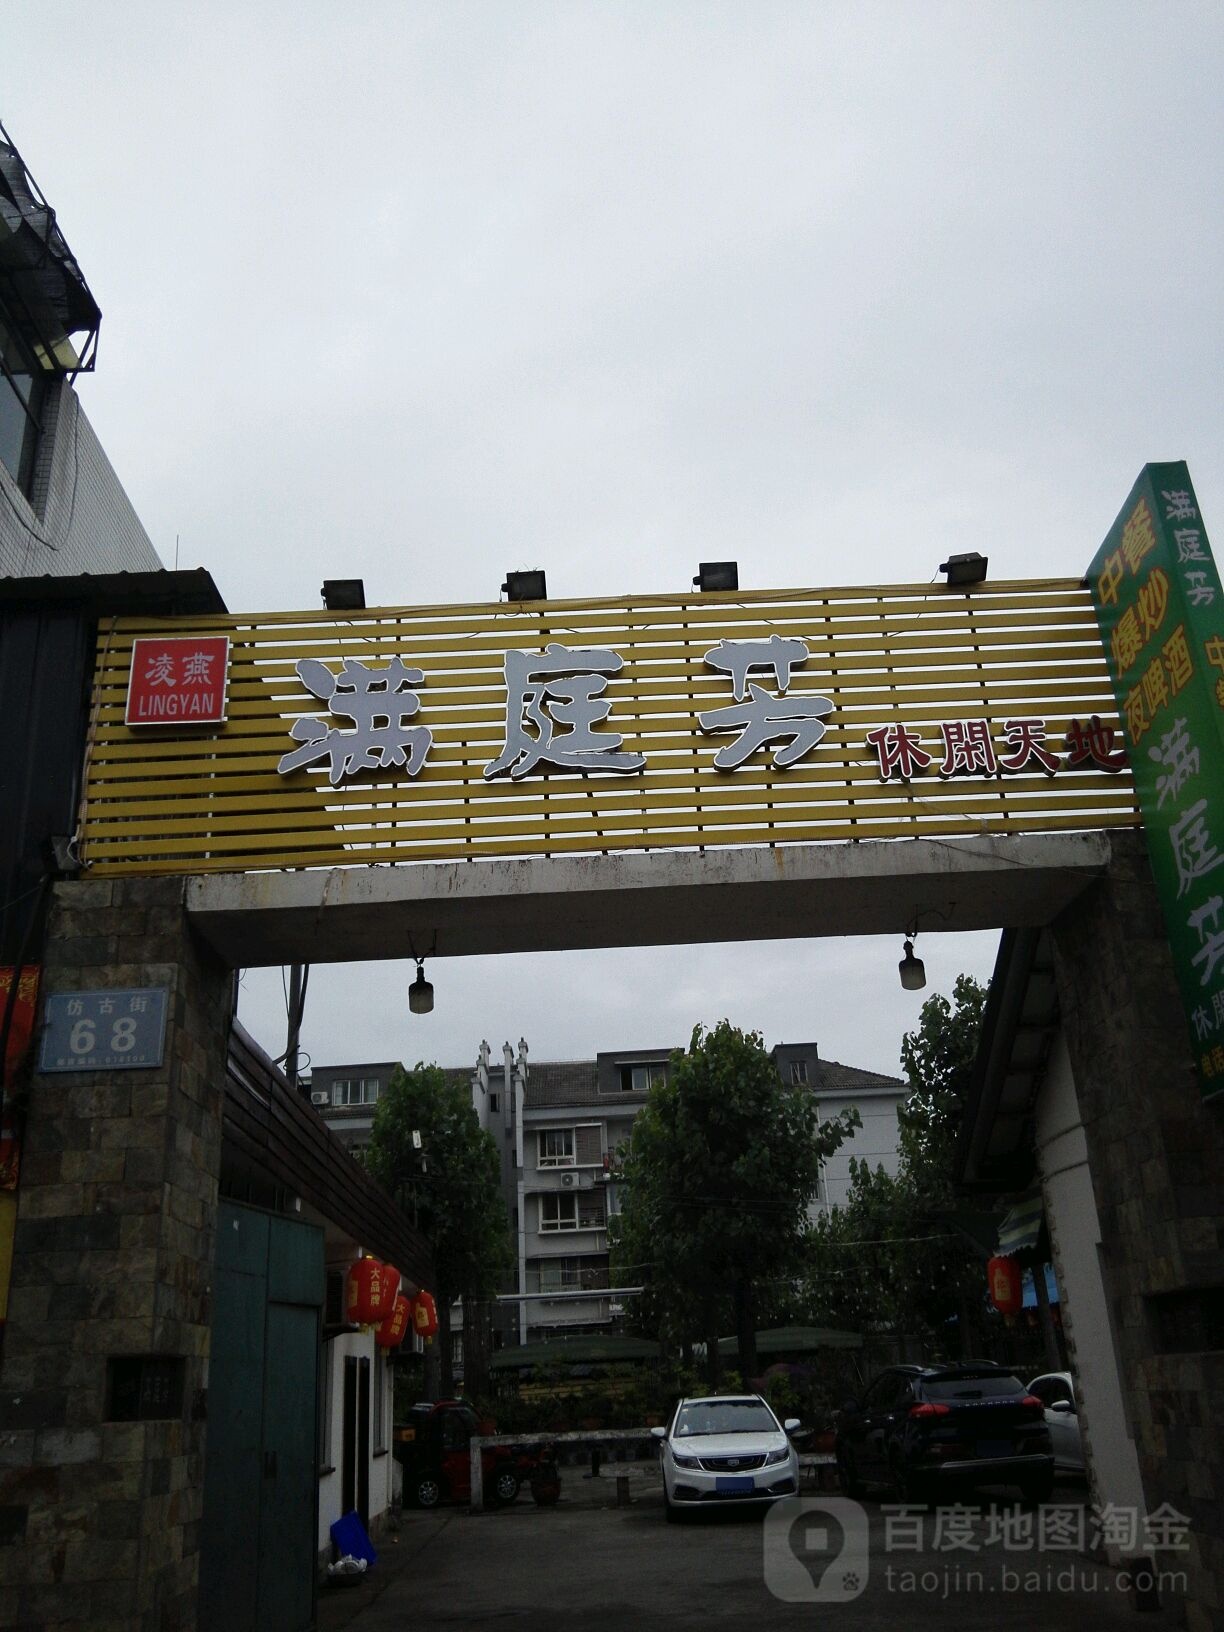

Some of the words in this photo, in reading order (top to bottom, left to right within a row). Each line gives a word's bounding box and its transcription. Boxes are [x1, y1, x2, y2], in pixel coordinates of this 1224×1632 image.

[144, 651, 216, 688] 凌燕
[1122, 622, 1194, 747] 夜啤酒
[138, 693, 214, 717] LINGYAN
[66, 995, 149, 1016] 仿古街
[69, 1016, 138, 1055] 68
